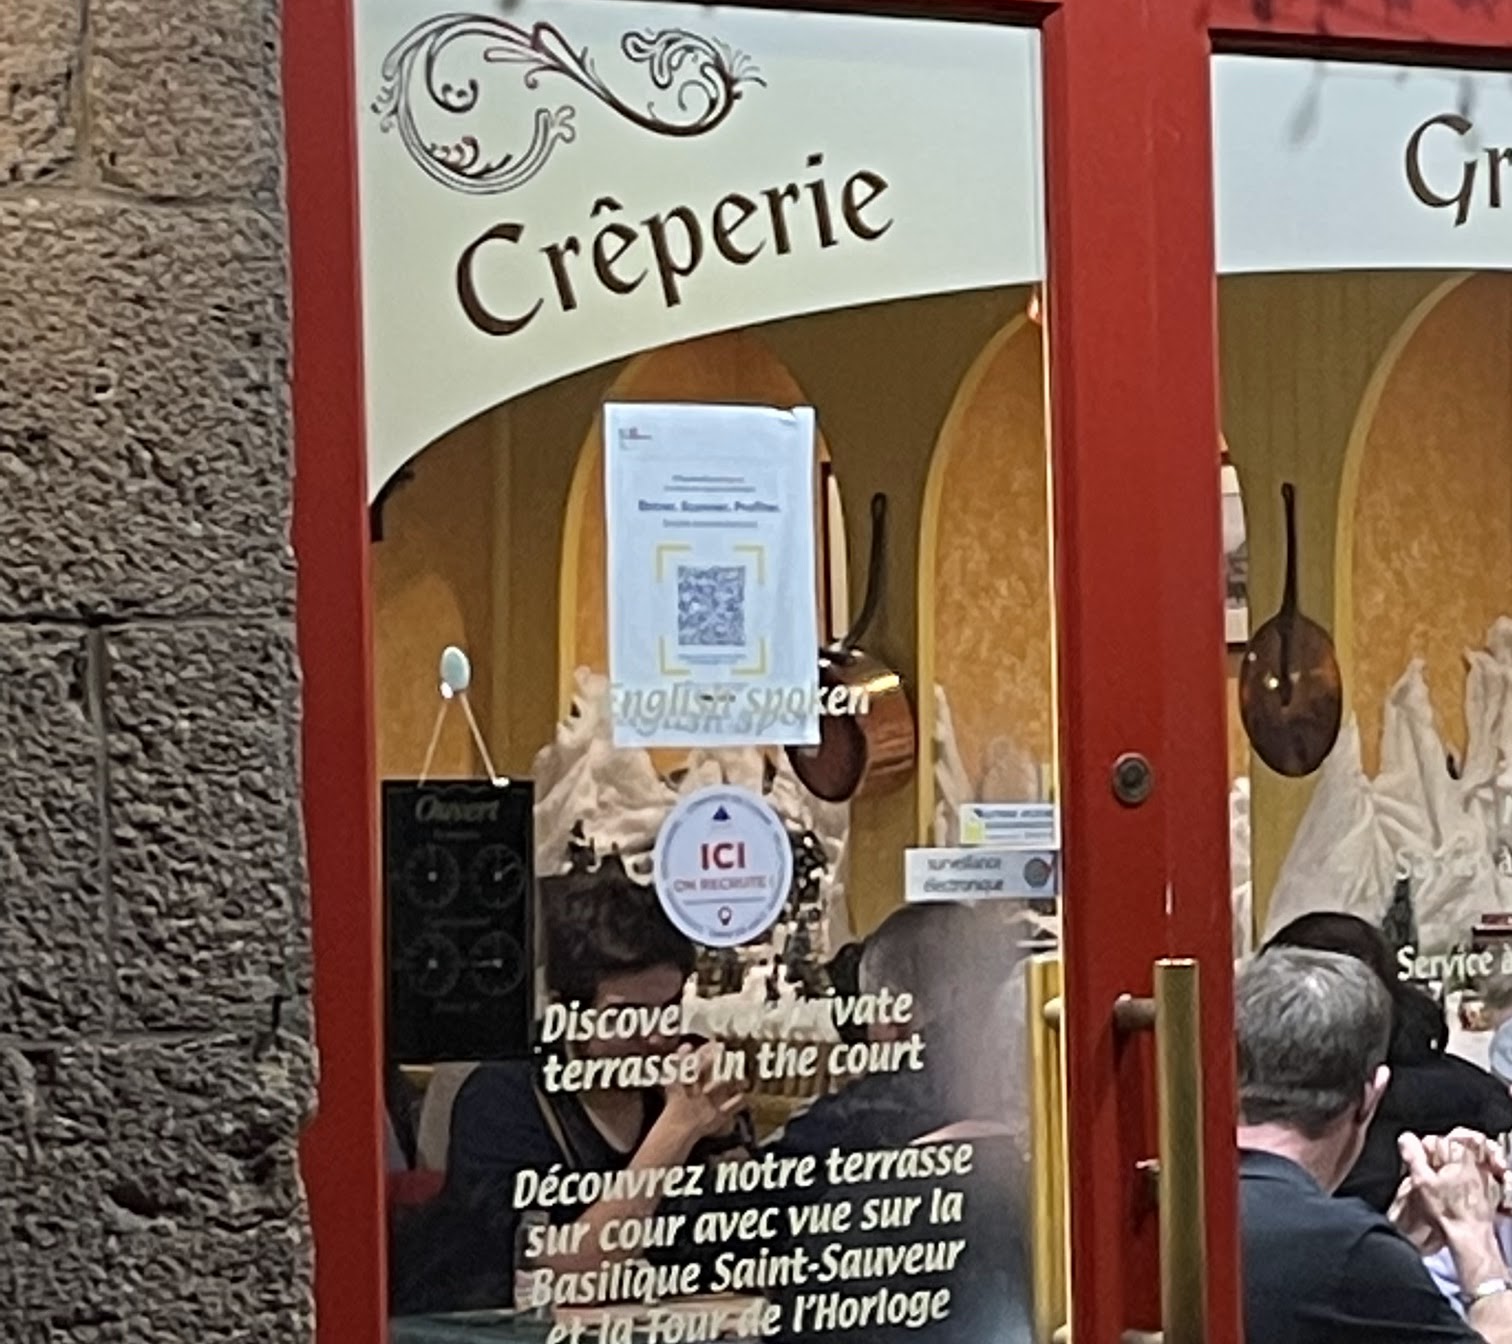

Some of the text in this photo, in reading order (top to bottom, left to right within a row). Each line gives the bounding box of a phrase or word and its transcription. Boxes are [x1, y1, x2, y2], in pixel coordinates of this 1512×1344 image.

[455, 153, 894, 337] Crêperie
[745, 679, 870, 724] spoken
[700, 840, 747, 872] ICI
[673, 878, 697, 894] ON
[1397, 943, 1494, 981] Service
[773, 988, 913, 1042] ivate
[541, 1032, 925, 1094] terrasse in the court
[513, 1142, 974, 1210] Découvrez notre terrasse
[525, 1187, 964, 1259] sur cour avec vue sur la
[528, 1235, 966, 1309] Basilique Saint-Sauveur
[736, 1296, 782, 1338] de
